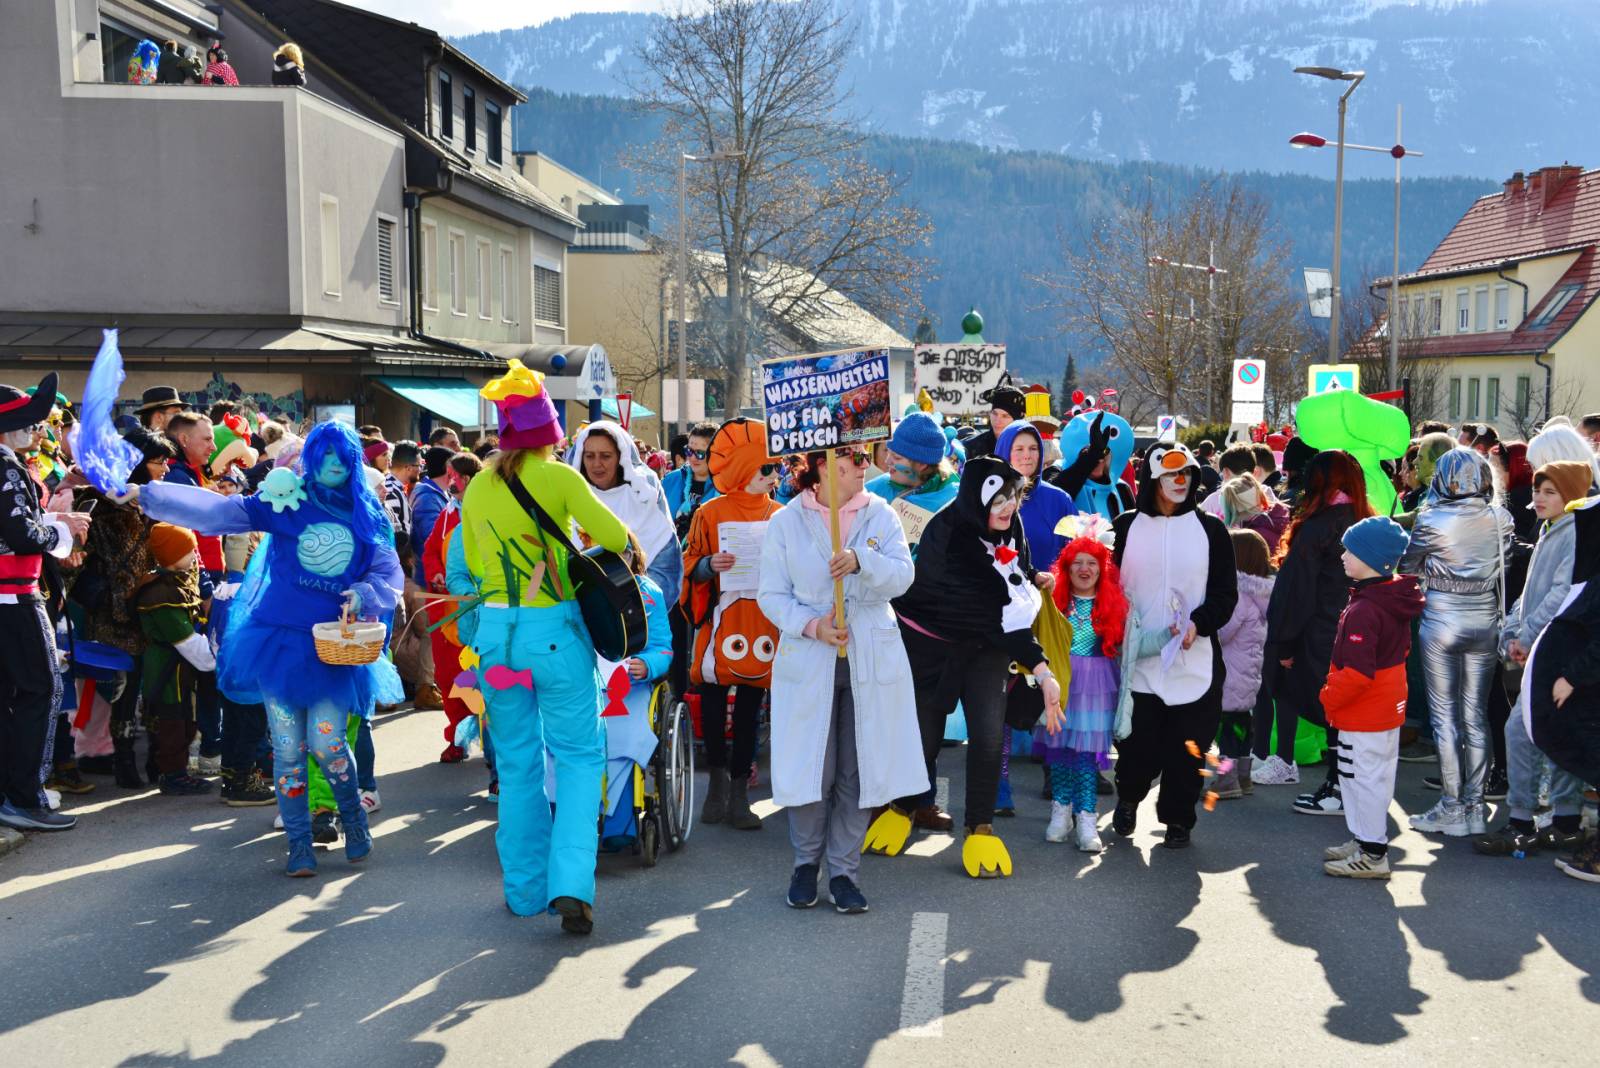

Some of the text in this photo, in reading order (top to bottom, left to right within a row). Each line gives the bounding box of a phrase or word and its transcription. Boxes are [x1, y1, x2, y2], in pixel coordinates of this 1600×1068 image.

[766, 359, 885, 405] WASSERWELTEN
[770, 406, 832, 431] OIS FIA
[771, 426, 838, 453] D'FISCH
